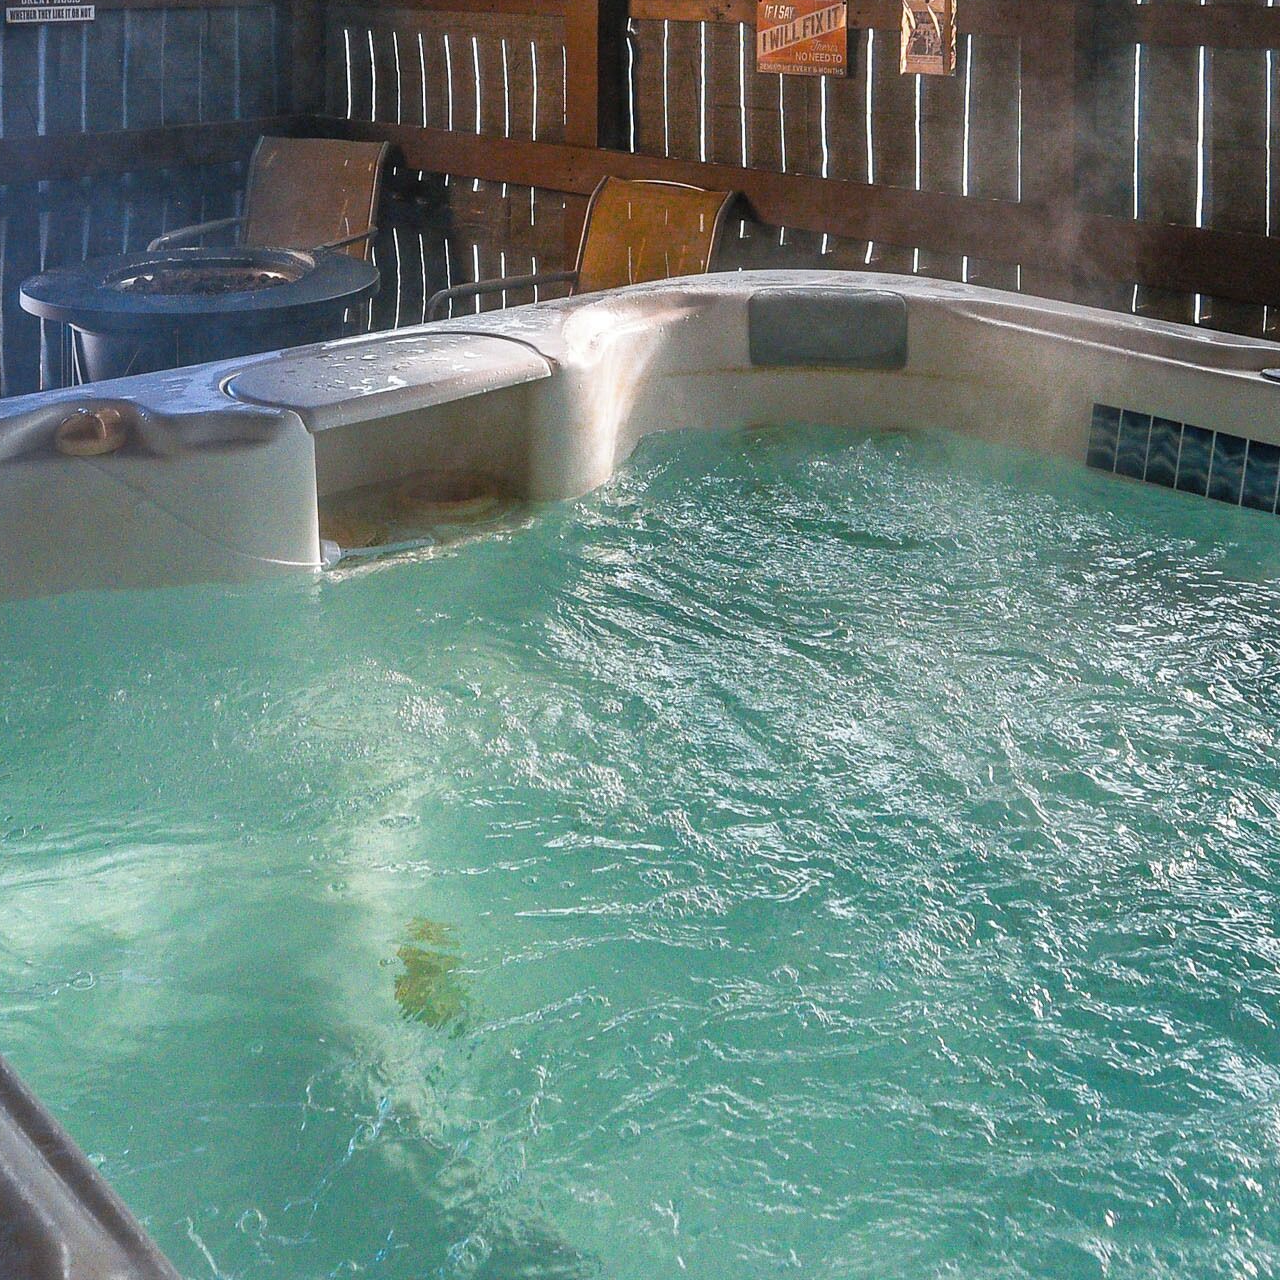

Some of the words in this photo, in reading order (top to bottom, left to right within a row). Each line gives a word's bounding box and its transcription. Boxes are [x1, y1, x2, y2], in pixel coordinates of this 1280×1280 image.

[765, 5, 773, 19] IF
[774, 5, 778, 19] I
[779, 5, 795, 20] SAY
[763, 33, 767, 52] I
[770, 22, 800, 50] WILL
[803, 12, 823, 38] FIX
[827, 6, 840, 30] IT
[795, 52, 808, 61] NO
[809, 53, 830, 62] NEED
[832, 54, 842, 63] TO
[819, 66, 843, 75] MONTHS
